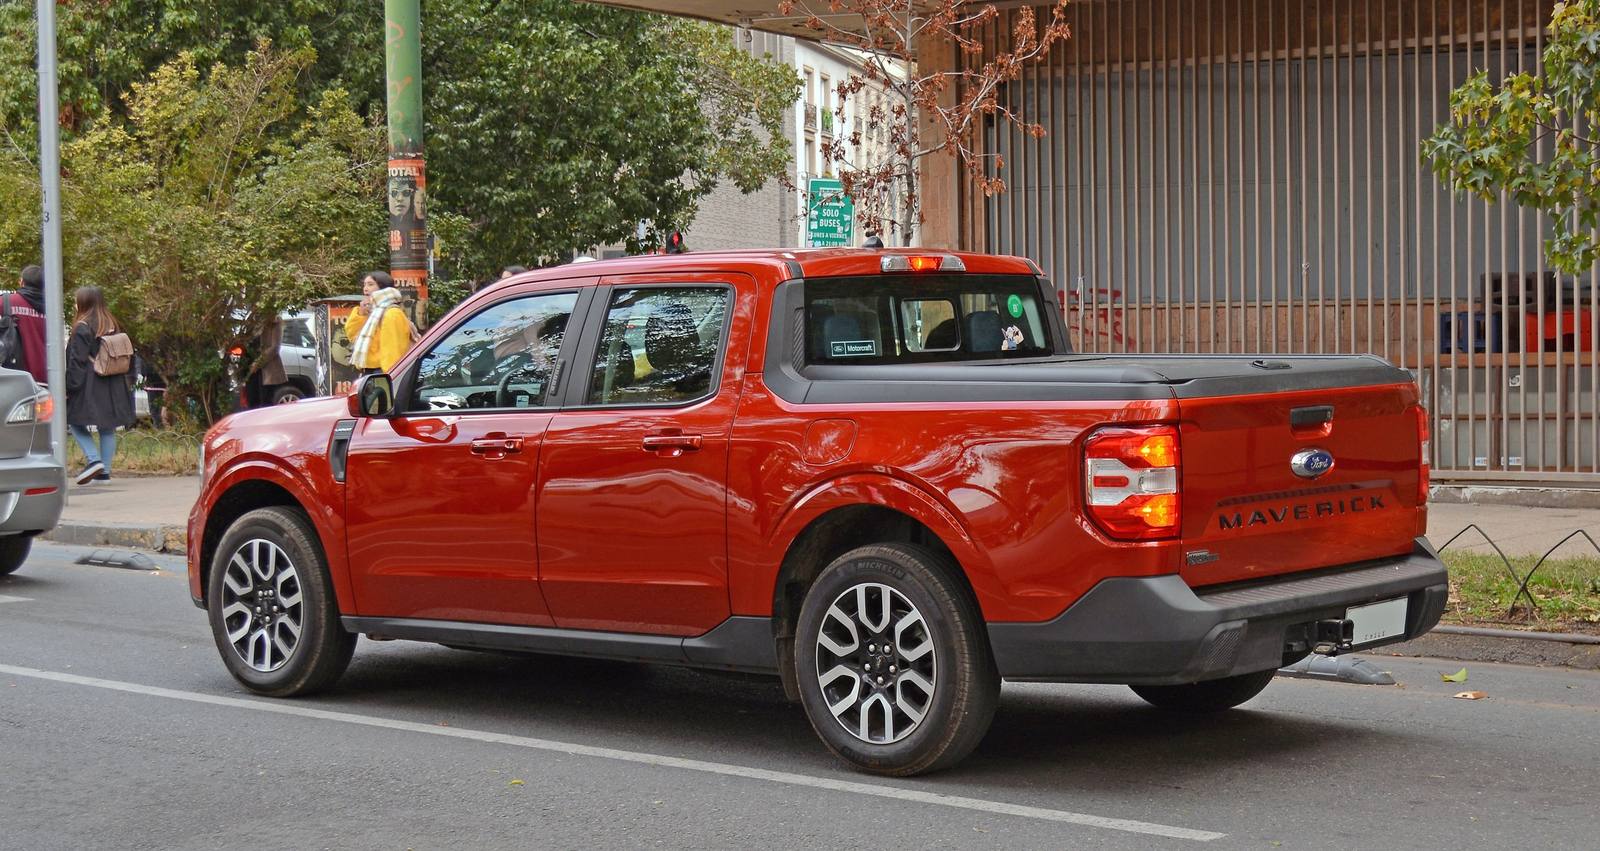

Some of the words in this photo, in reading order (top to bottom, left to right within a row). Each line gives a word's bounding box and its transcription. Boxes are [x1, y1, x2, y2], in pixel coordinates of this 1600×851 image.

[822, 208, 840, 217] SOLO
[819, 219, 841, 228] BUSES
[393, 277, 421, 287] OTAL
[847, 344, 873, 352] Motorcraft
[1218, 494, 1385, 530] MAVERICK
[857, 561, 906, 580] MICHELIN
